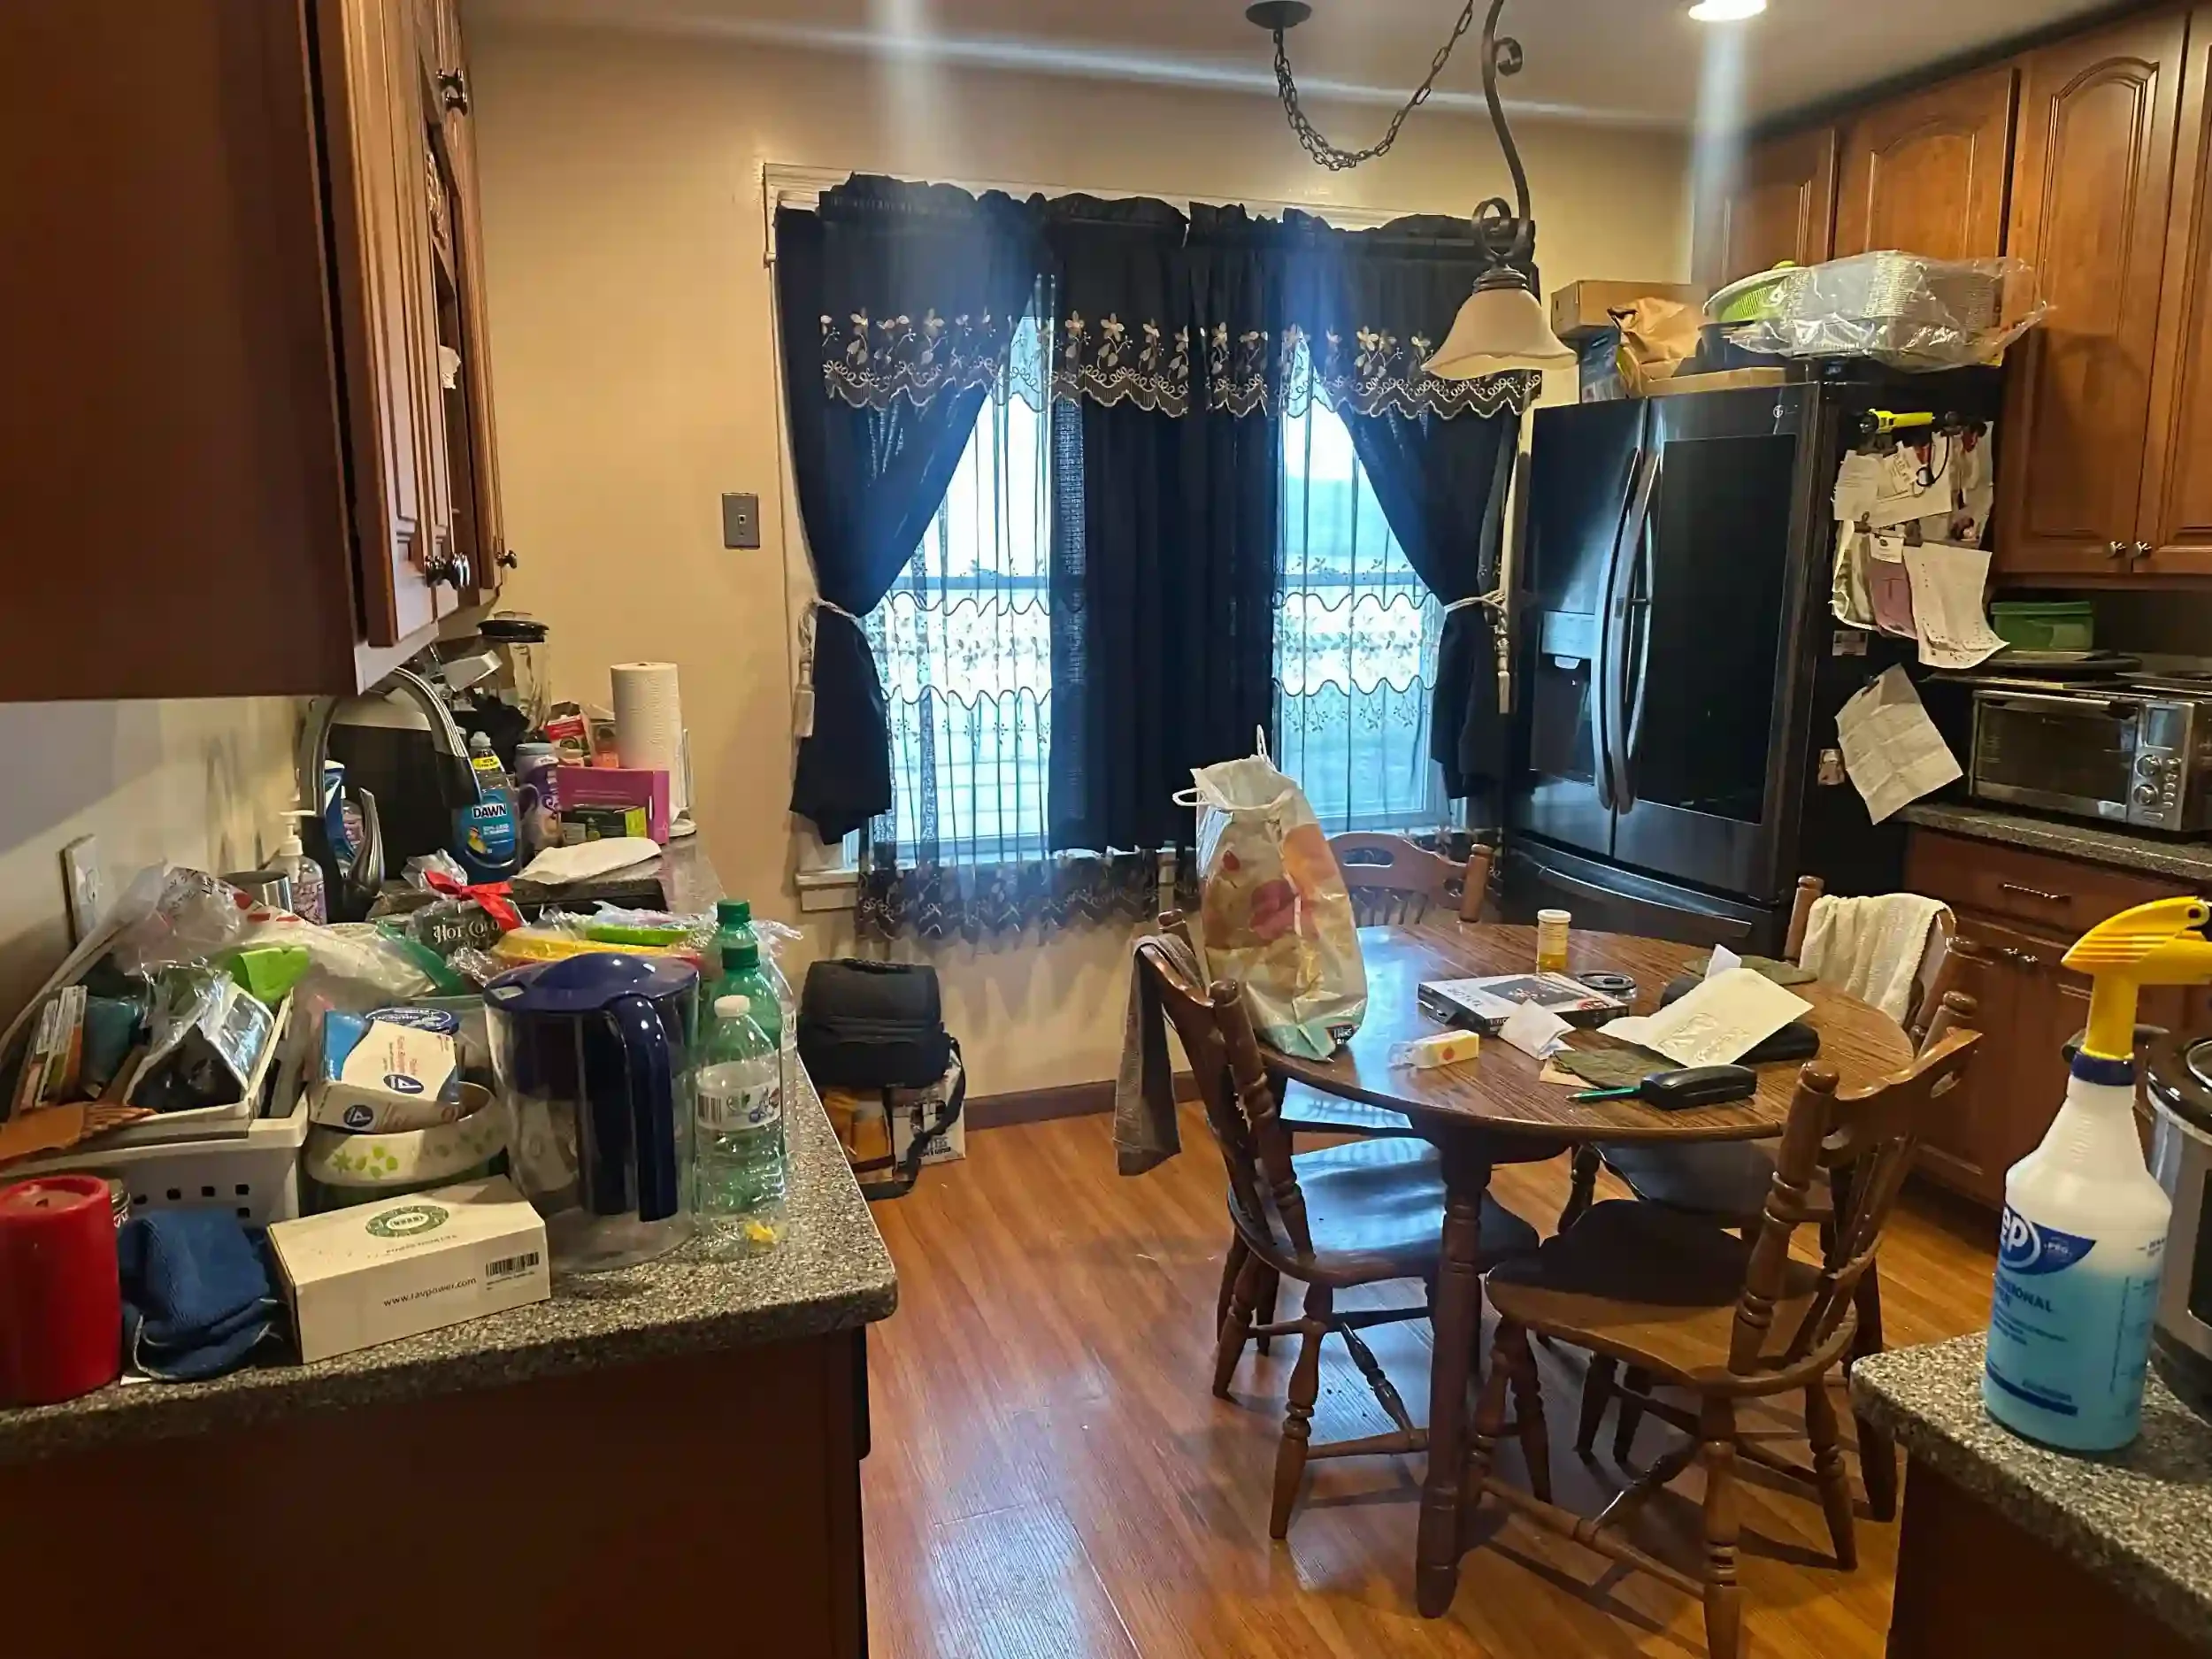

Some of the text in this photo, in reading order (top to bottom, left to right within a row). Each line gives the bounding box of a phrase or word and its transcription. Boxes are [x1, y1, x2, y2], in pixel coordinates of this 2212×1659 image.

[473, 804, 507, 818] DAWN
[432, 919, 502, 945] Hot Coco
